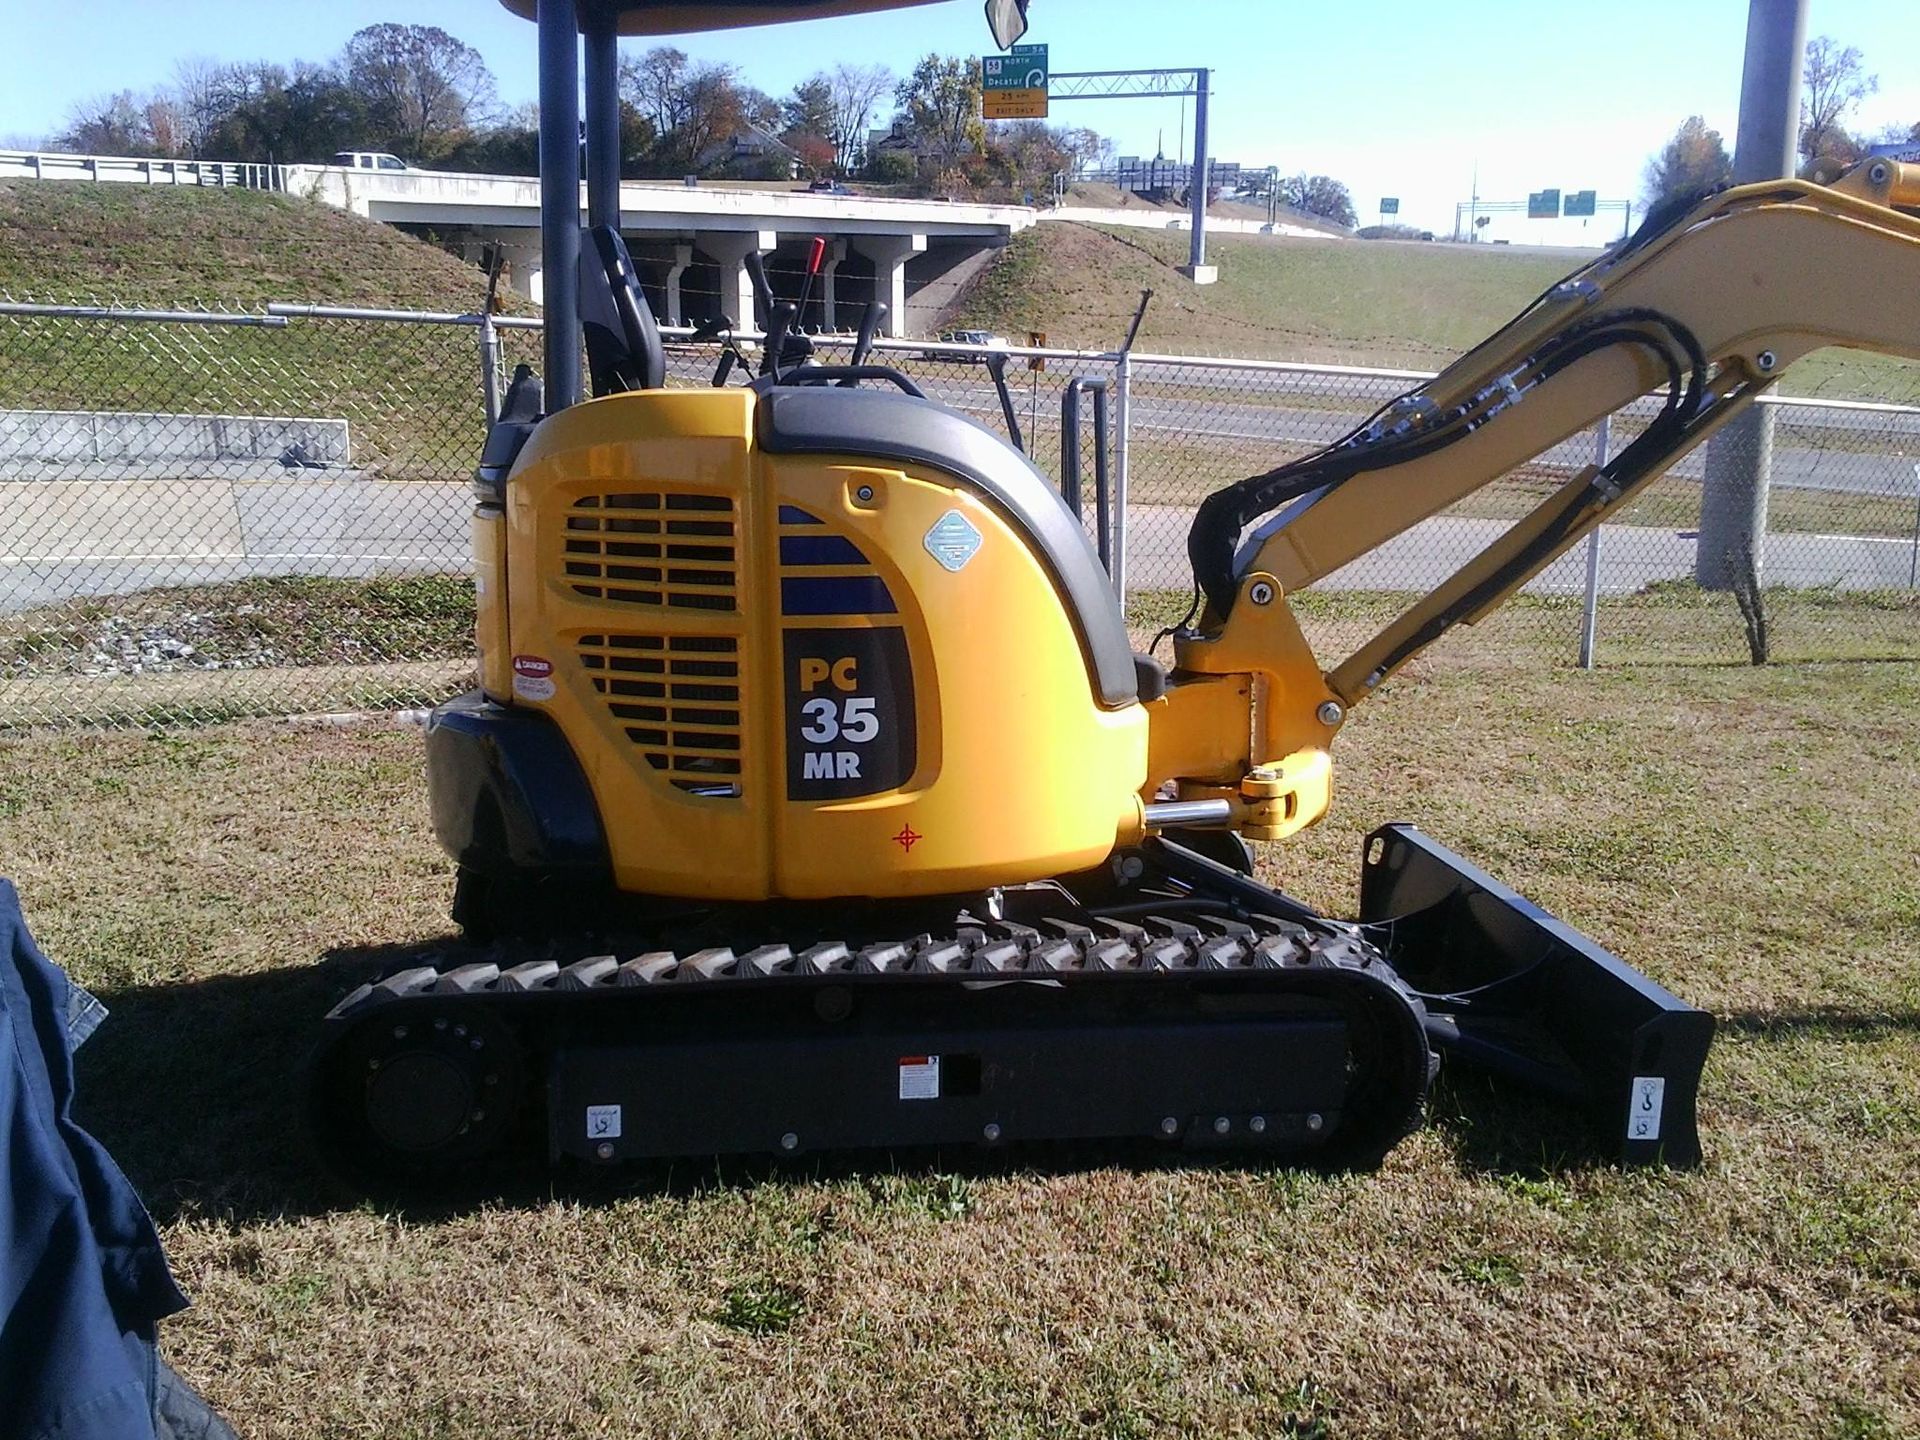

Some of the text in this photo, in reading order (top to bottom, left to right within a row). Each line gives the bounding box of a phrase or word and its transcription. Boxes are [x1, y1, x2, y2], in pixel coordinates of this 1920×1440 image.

[989, 78, 1023, 86] Decatur
[1001, 92, 1013, 100] 25
[799, 656, 858, 692] PC
[800, 697, 880, 744] 35
[803, 751, 862, 779] MR
